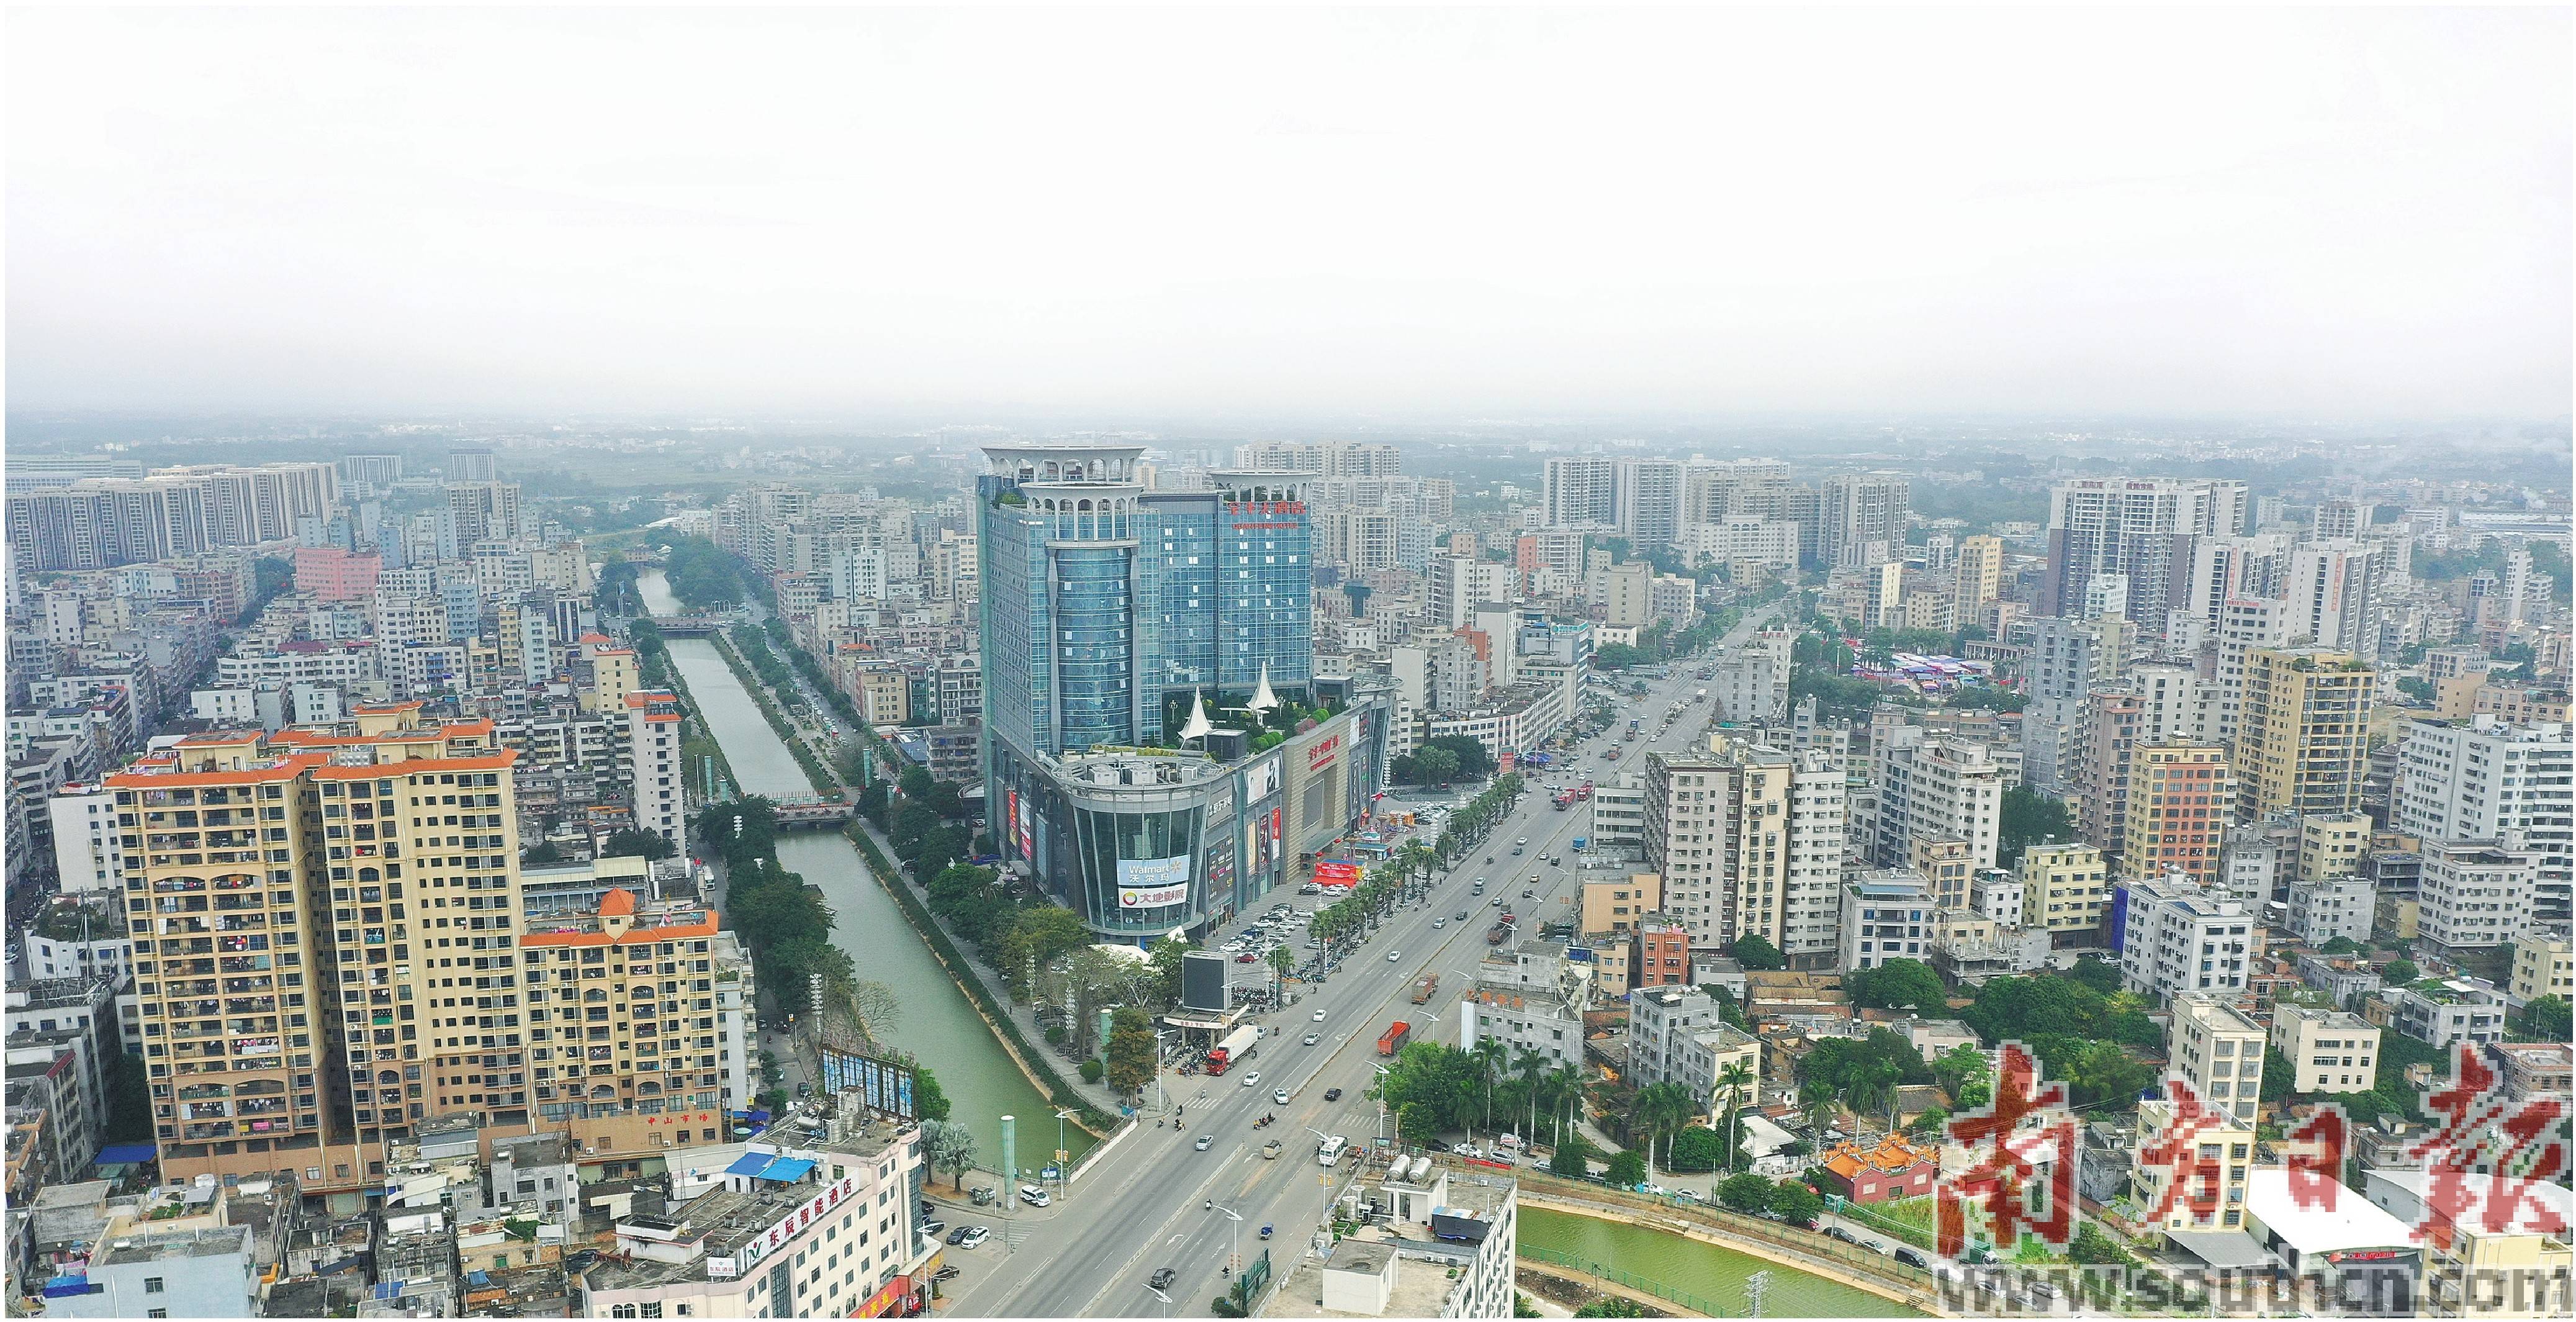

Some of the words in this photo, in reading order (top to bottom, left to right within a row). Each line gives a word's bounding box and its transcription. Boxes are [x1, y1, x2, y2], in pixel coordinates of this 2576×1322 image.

[1129, 864, 1169, 874] Walmart
[1130, 873, 1169, 882] 沃尔玛
[1140, 889, 1184, 903] 大地影院
[648, 1113, 708, 1126] 中山市场
[768, 1178, 851, 1248] 东辰智能酒店
